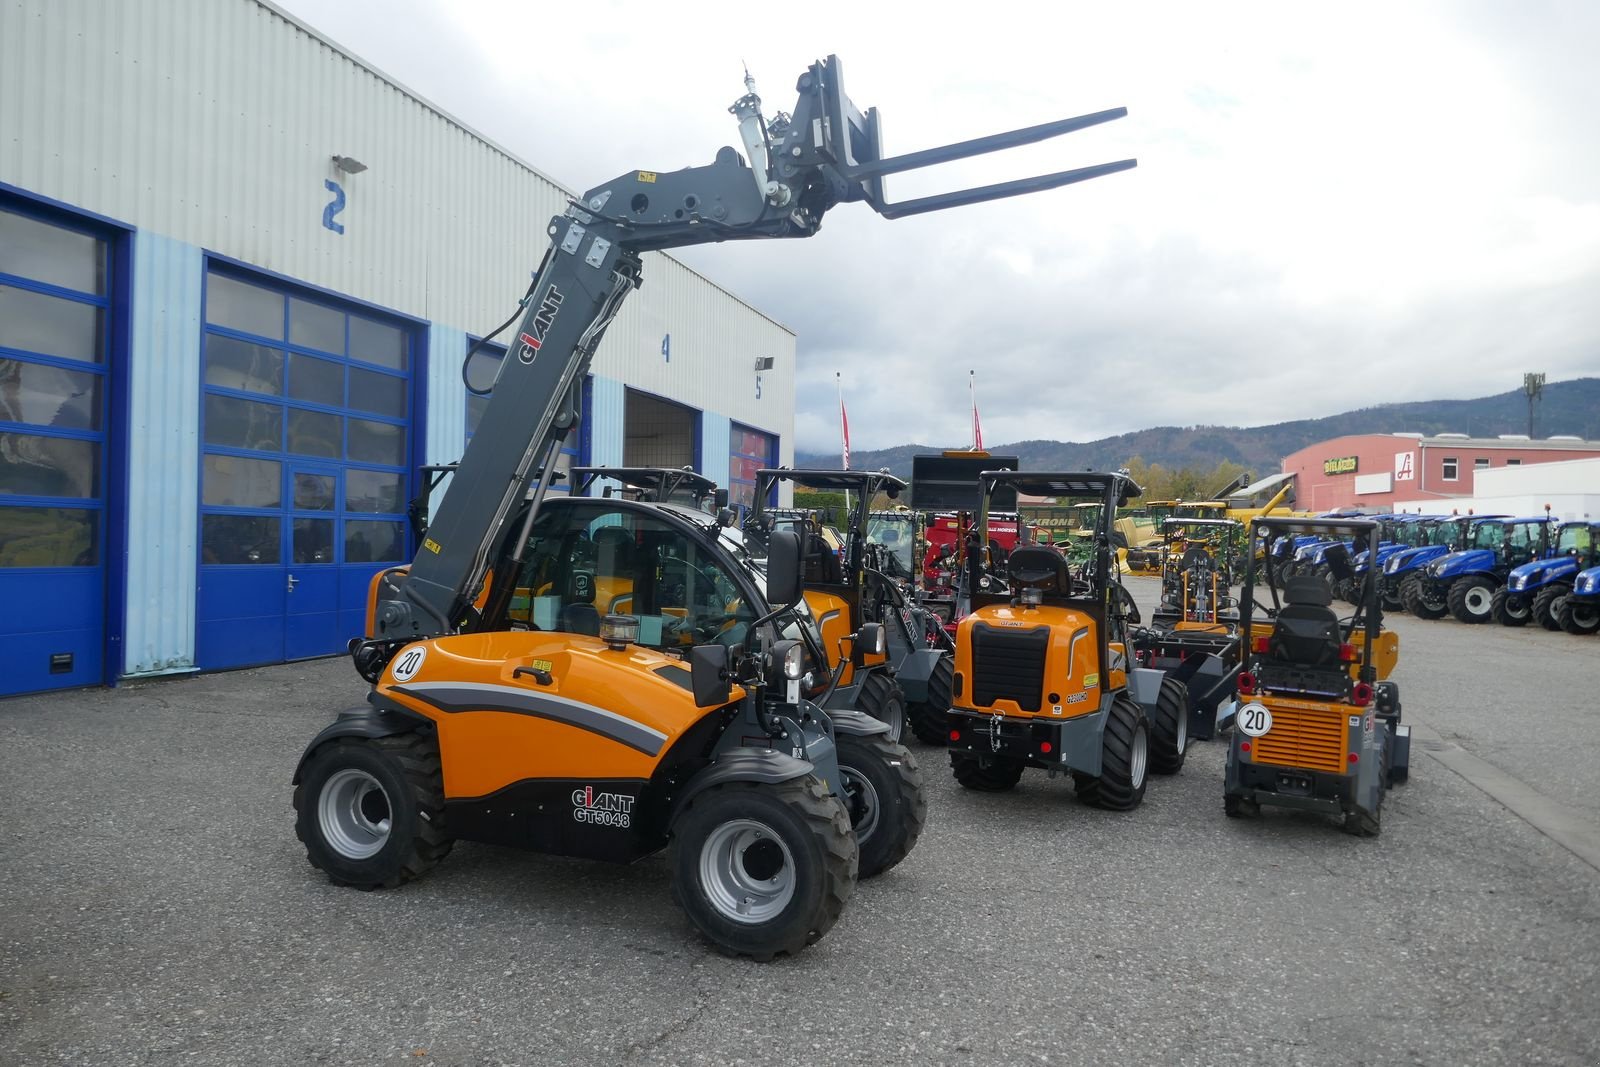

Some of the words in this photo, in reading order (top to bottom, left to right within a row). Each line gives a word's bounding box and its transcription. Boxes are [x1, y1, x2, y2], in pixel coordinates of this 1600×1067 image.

[323, 179, 345, 235] 2
[661, 333, 670, 363] 4
[756, 375, 761, 399] 5
[1034, 518, 1076, 526] KRONE
[396, 651, 421, 675] 20
[1245, 709, 1265, 731] 20
[572, 786, 634, 813] GIANT
[574, 808, 630, 828] GT5048
